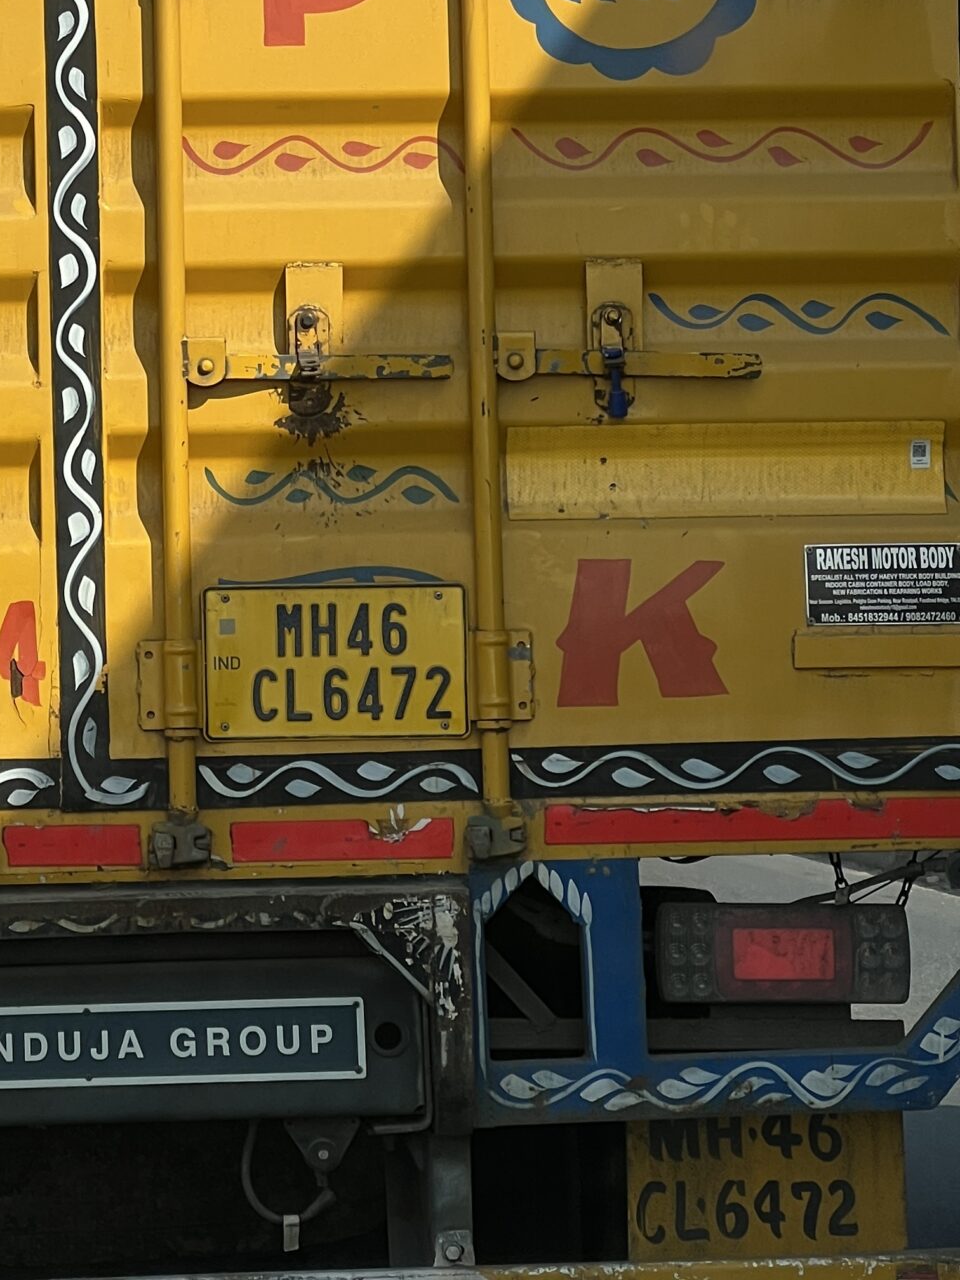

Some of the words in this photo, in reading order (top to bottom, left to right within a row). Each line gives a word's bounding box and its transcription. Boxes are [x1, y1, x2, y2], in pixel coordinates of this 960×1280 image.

[816, 547, 869, 570] RAKESH
[871, 547, 918, 570] MOTOR
[920, 546, 955, 569] BODY
[275, 602, 408, 658] MH46
[556, 558, 730, 708] K
[847, 612, 899, 622] 8451832944
[905, 611, 957, 621] 9082472460
[213, 655, 241, 670] IND
[252, 666, 453, 722] CL6472
[170, 1023, 335, 1060] GROUP
